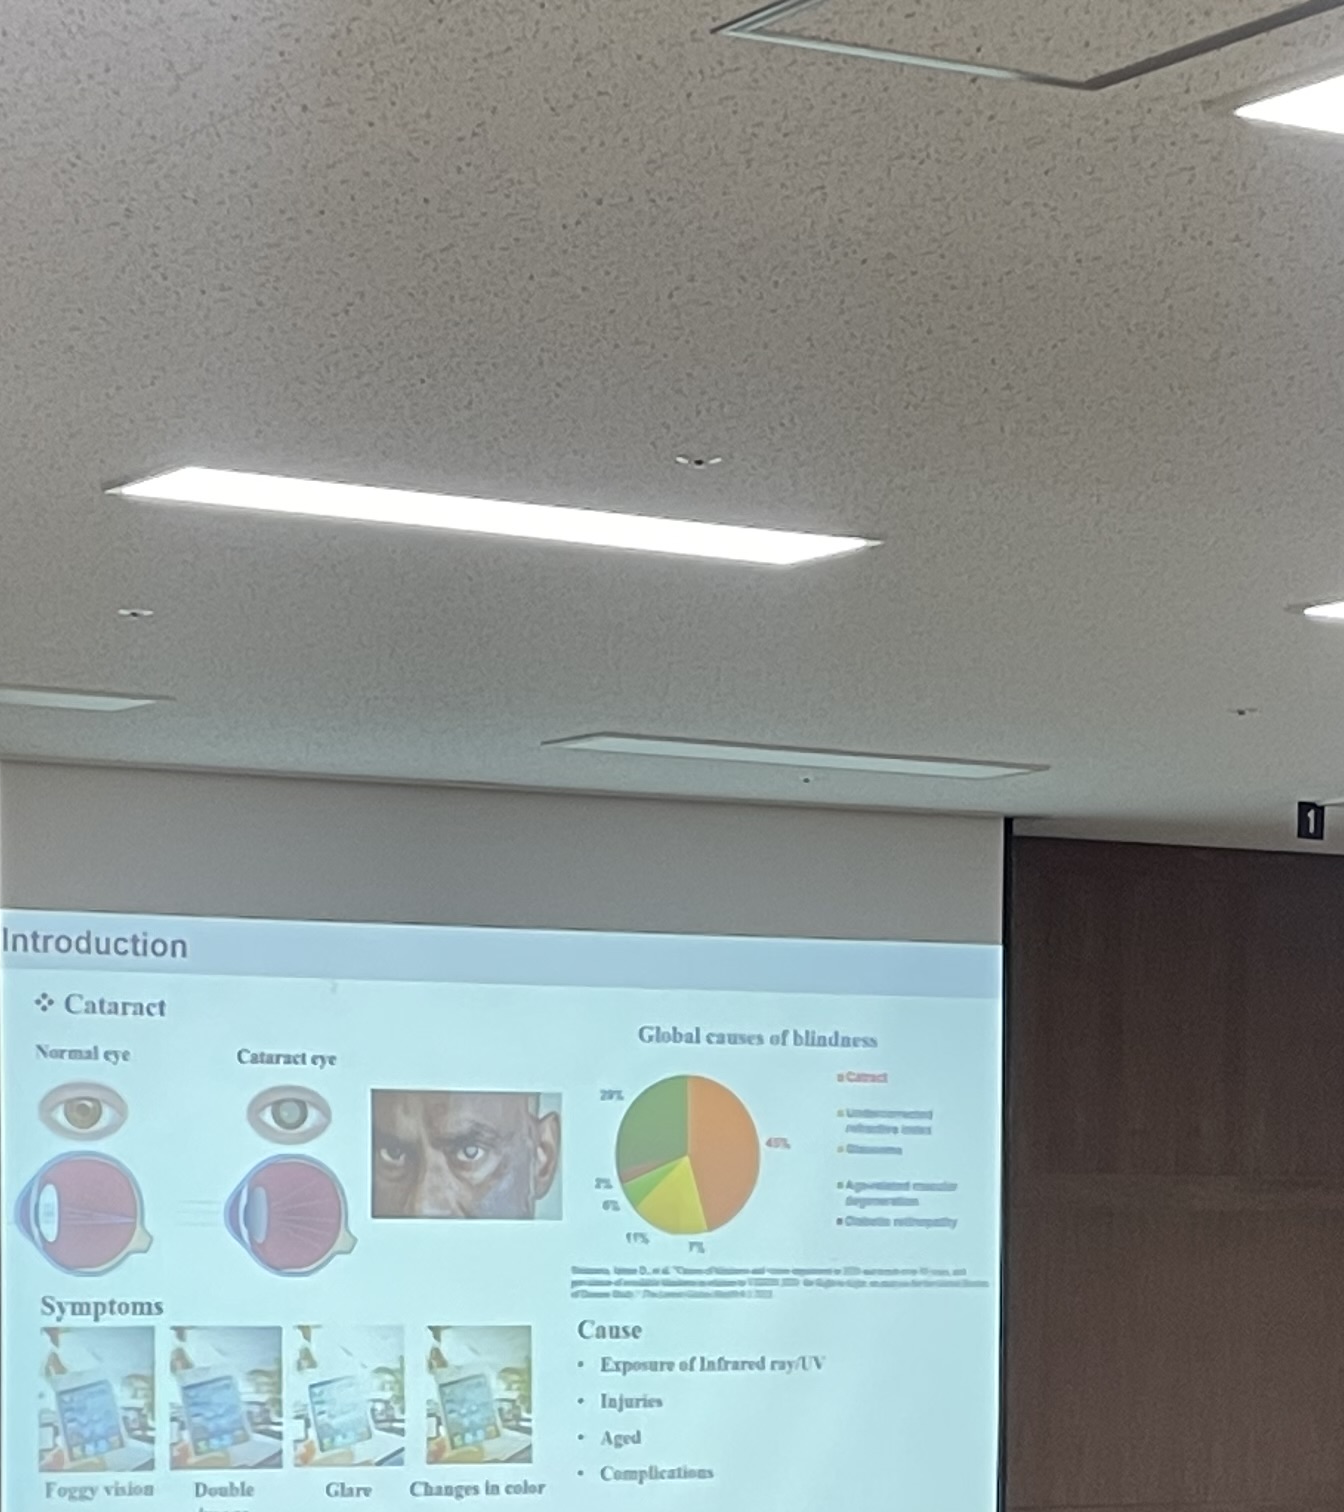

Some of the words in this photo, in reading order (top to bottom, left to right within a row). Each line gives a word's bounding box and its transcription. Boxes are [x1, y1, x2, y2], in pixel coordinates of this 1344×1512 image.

[1307, 808, 1315, 834] 1
[2, 927, 188, 959] Introduction
[64, 993, 167, 1018] Cataract
[638, 1025, 701, 1046] Global
[705, 1031, 764, 1047] causes
[769, 1028, 790, 1047] of
[792, 1029, 878, 1049] blindness
[35, 1043, 99, 1063] Normal
[103, 1048, 131, 1066] eye
[236, 1048, 308, 1067] Cataract
[311, 1051, 337, 1070] eye
[40, 1295, 164, 1322] Symptoms
[577, 1318, 643, 1340] Cause
[600, 1356, 675, 1376] Exposure
[678, 1356, 697, 1373] of
[699, 1356, 766, 1372] Infrared
[769, 1355, 826, 1375] ray/UV
[600, 1392, 663, 1413] Injuries
[601, 1429, 641, 1447] Aged
[600, 1465, 714, 1485] Complications
[44, 1481, 99, 1502] Foggy
[102, 1482, 154, 1498] vision
[194, 1481, 255, 1499] Double
[325, 1481, 373, 1499] Glare
[409, 1480, 481, 1500] Changes
[485, 1480, 500, 1497] in
[503, 1480, 546, 1497] color
